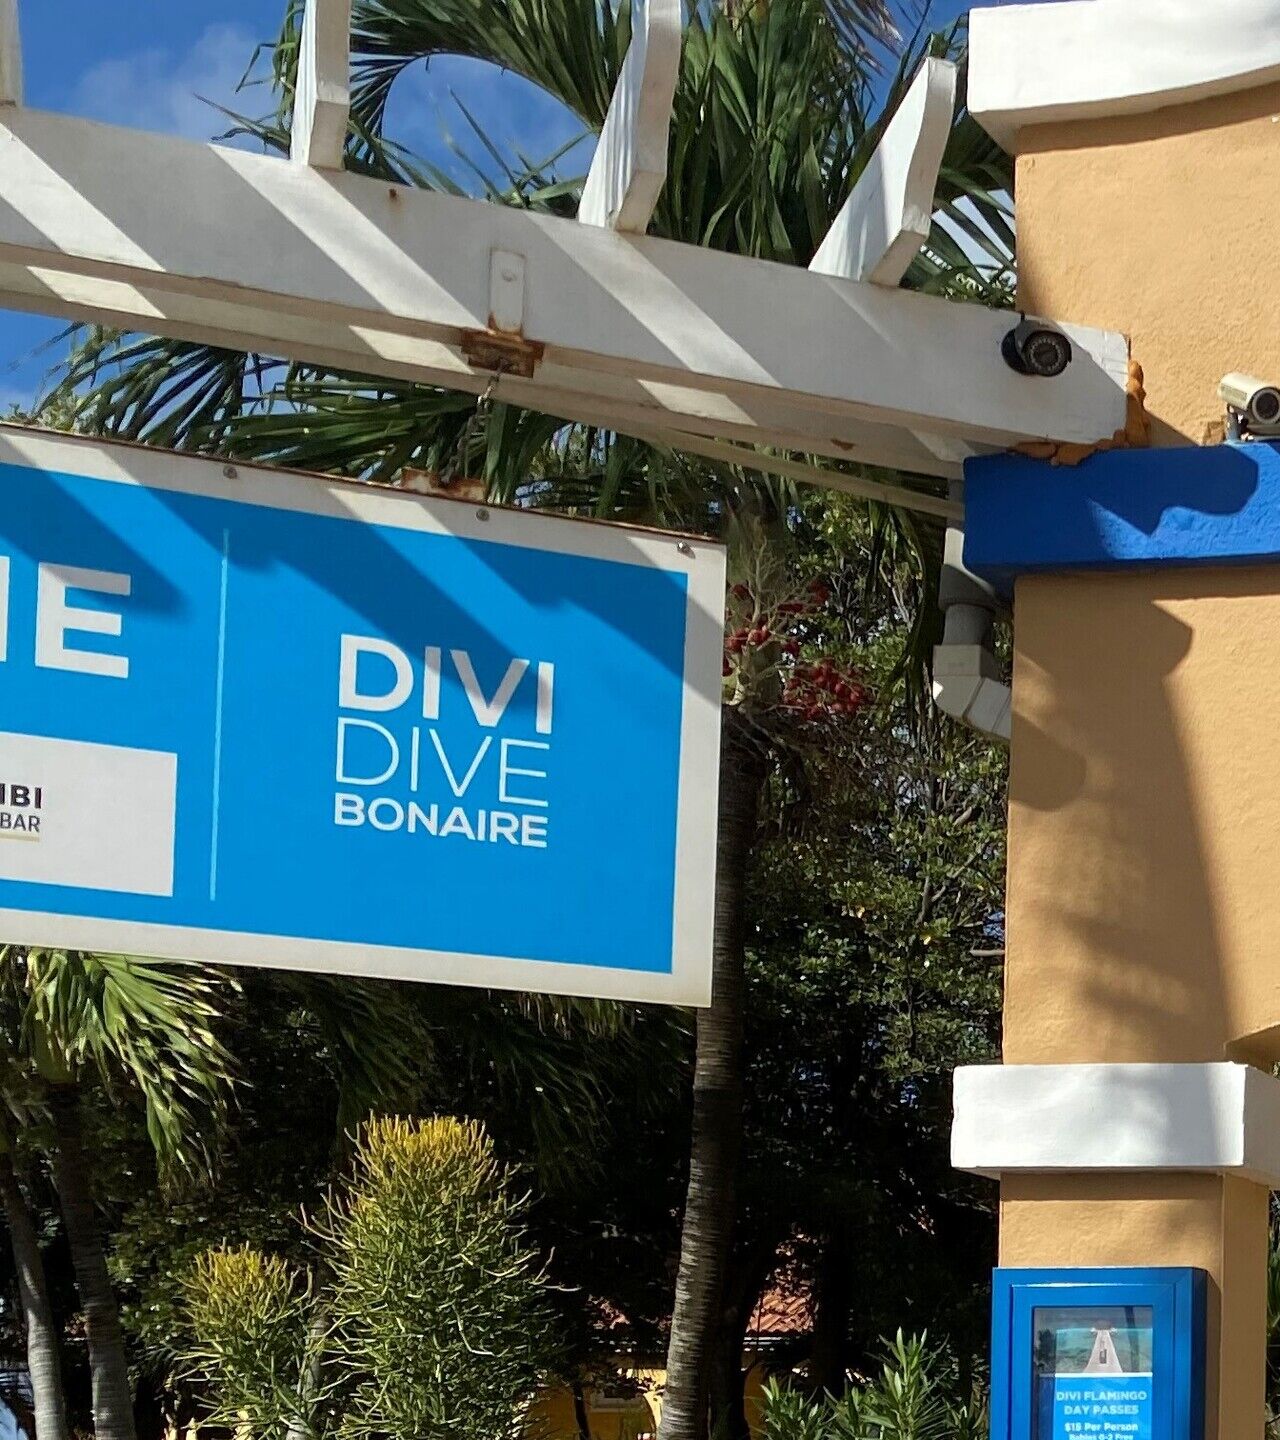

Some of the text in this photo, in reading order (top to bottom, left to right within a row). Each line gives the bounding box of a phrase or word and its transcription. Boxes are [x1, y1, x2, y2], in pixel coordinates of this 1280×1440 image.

[0, 555, 131, 679] E
[338, 633, 554, 734] DIVI
[336, 717, 550, 807] DIVE
[0, 812, 40, 832] BAR
[335, 792, 548, 848] BONAIRE
[1056, 1391, 1147, 1401] DIVI FLAMINGO
[1064, 1405, 1139, 1415] DAY PASSES
[1084, 1422, 1101, 1431] Per
[1104, 1422, 1138, 1431] Person
